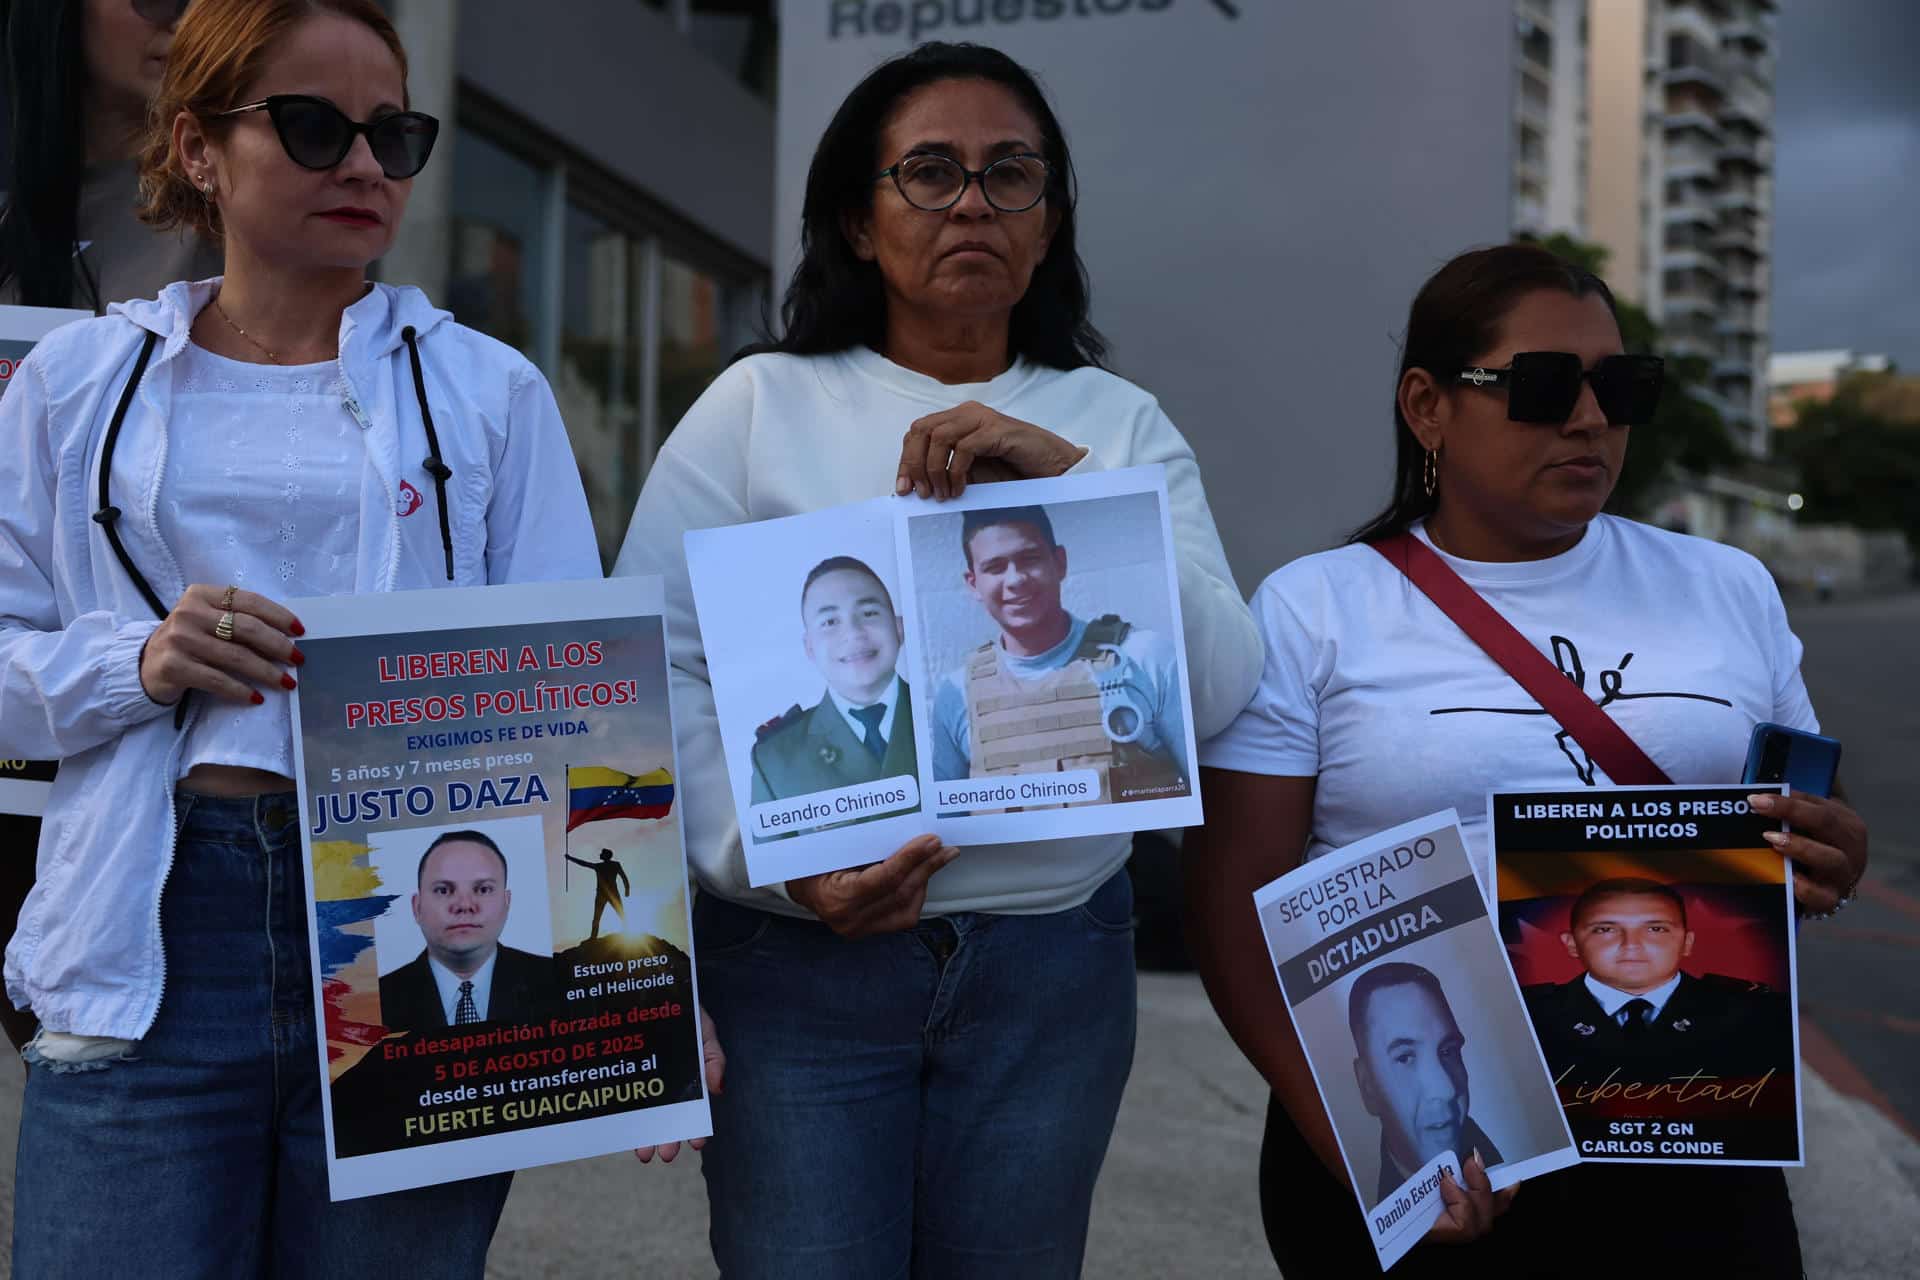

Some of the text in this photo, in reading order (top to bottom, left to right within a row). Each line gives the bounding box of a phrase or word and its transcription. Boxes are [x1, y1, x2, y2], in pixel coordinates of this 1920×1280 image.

[378, 641, 604, 683] LIBEREN A LOS
[345, 679, 638, 729] PRESOS POLÍTICOS!
[407, 720, 589, 750] EXIGIMOS FE DE VIDA
[331, 752, 534, 782] 5 años y 7 meses preso
[312, 773, 550, 834] JUSTO DAZA
[759, 787, 906, 829] Leandro Chirinos
[938, 778, 1087, 806] Leonardo Chirinos
[1514, 799, 1757, 820] LIBEREN A LOS PRESO
[1585, 822, 1698, 840] POLITICOS
[1279, 837, 1436, 924] SECUESTRADO
[1317, 883, 1396, 933] POR LA
[1307, 904, 1443, 984] DICTADURA
[566, 972, 675, 1001] en el Helicoide
[573, 954, 669, 979] Estuvo preso
[383, 1000, 682, 1061] En desaparición forzada desde
[434, 1034, 645, 1082] 5 DE AGOSTO DE 2025
[418, 1053, 658, 1107] desde su transferencia al
[404, 1077, 665, 1137] FUERTE GUAICAIPURO
[1582, 1140, 1725, 1155] CARLOS CONDE
[1609, 1122, 1694, 1136] SGT 2 GN
[1375, 1197, 1411, 1235] Danilo
